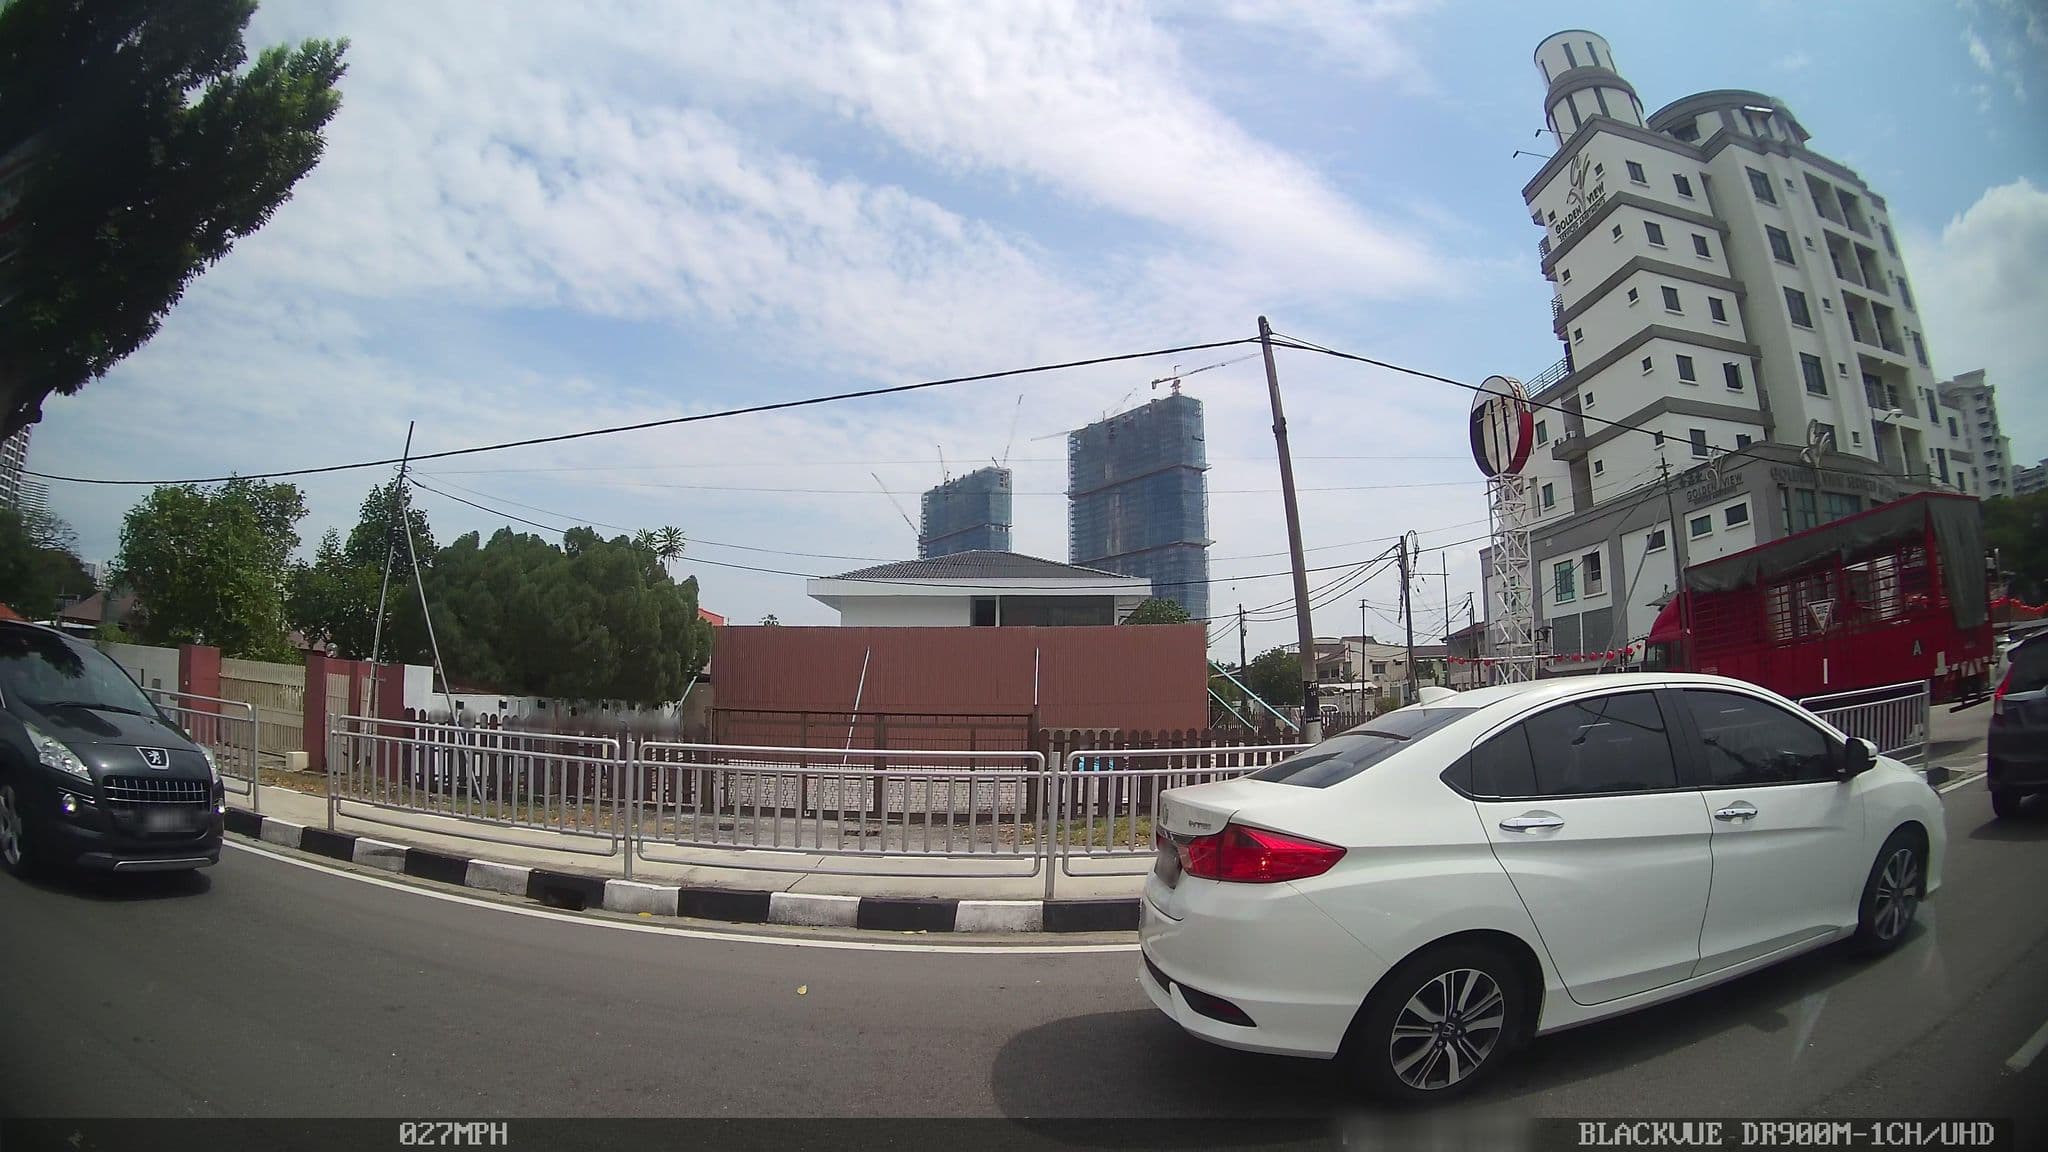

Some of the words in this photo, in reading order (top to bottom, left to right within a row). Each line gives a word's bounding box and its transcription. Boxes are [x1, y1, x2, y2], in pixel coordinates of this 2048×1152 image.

[1555, 205, 1582, 234] GOLDEN
[1586, 181, 1605, 204] VIEW
[1723, 472, 1743, 488] VIEW
